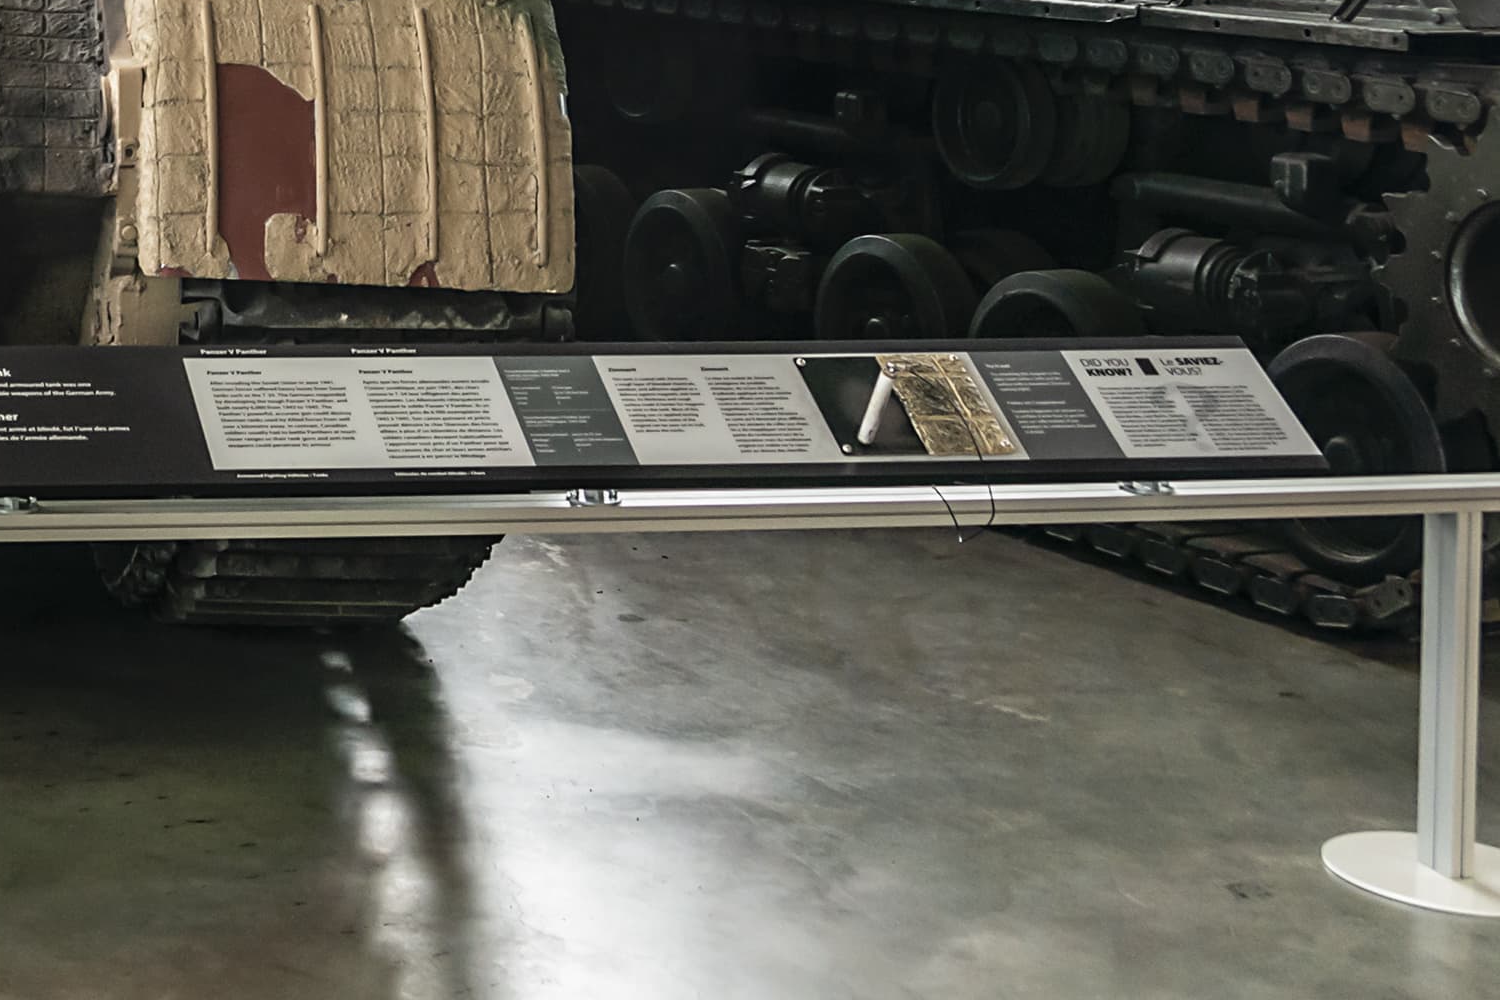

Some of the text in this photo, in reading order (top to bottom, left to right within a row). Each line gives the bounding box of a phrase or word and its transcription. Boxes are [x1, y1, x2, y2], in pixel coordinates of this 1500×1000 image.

[1080, 358, 1129, 367] DID YOU
[1160, 357, 1224, 366] Le SAVIEZ-
[1086, 368, 1133, 377] KNOW?
